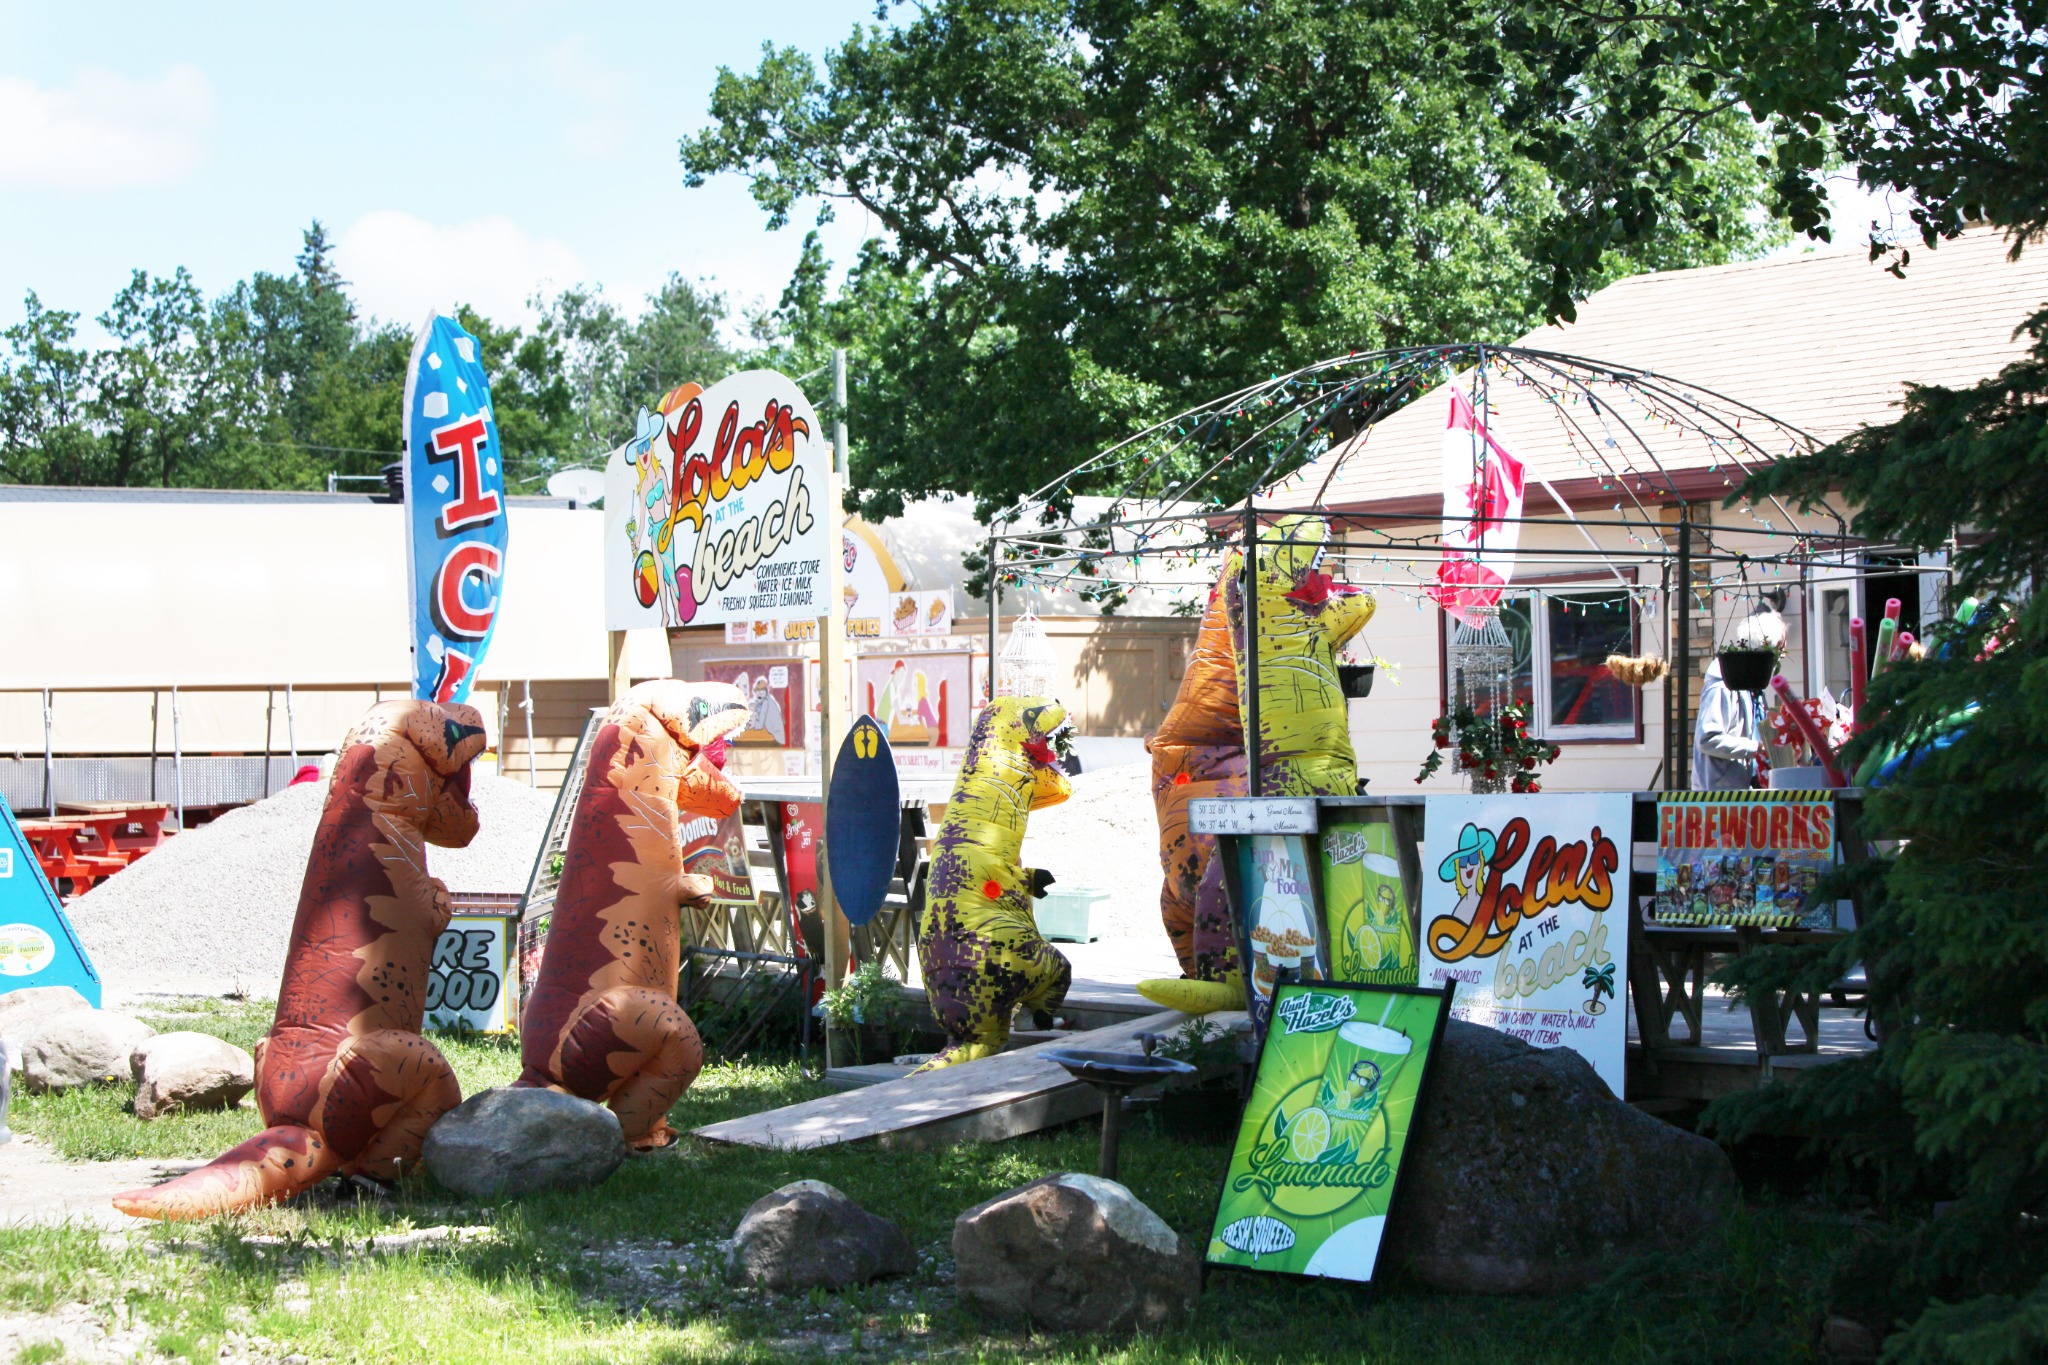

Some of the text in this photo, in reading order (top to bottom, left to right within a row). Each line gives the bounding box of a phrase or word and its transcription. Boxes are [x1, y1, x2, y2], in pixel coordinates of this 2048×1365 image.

[658, 398, 809, 553] Lola's
[714, 497, 745, 525] AT THE
[691, 465, 814, 605] beach
[757, 560, 820, 580] CONVENIENCE STORE
[757, 577, 813, 593] WATER ICE MILK
[722, 591, 813, 612] FRESHLY SQUEEZED LEMONADE
[784, 618, 880, 640] JUST FRIES
[1230, 804, 1236, 814] N
[678, 817, 718, 847] Donuts
[1323, 832, 1340, 851] Aunt
[1660, 804, 1831, 850] FIREWORKS
[1331, 832, 1368, 866] Hazel's
[714, 875, 751, 896] Hot & Fresh
[1427, 817, 1618, 964] Lola's
[431, 929, 495, 970] RE
[1518, 915, 1560, 954] AT THE
[1342, 949, 1419, 984] Lemonade
[1494, 911, 1611, 999] beach
[424, 969, 500, 1011] OOD
[1453, 969, 1482, 984] DONUTS
[1278, 992, 1312, 1017] Aunt
[1285, 995, 1357, 1034] Hazel's
[1511, 1011, 1537, 1026] CANDY
[1541, 1013, 1568, 1028] WATER
[1568, 1009, 1576, 1030] &
[1575, 1015, 1596, 1029] MILK
[1535, 1030, 1562, 1044] ITEMS
[1233, 1135, 1392, 1201] Lemonade
[1222, 1215, 1296, 1262] FRESH SQUEEZED
